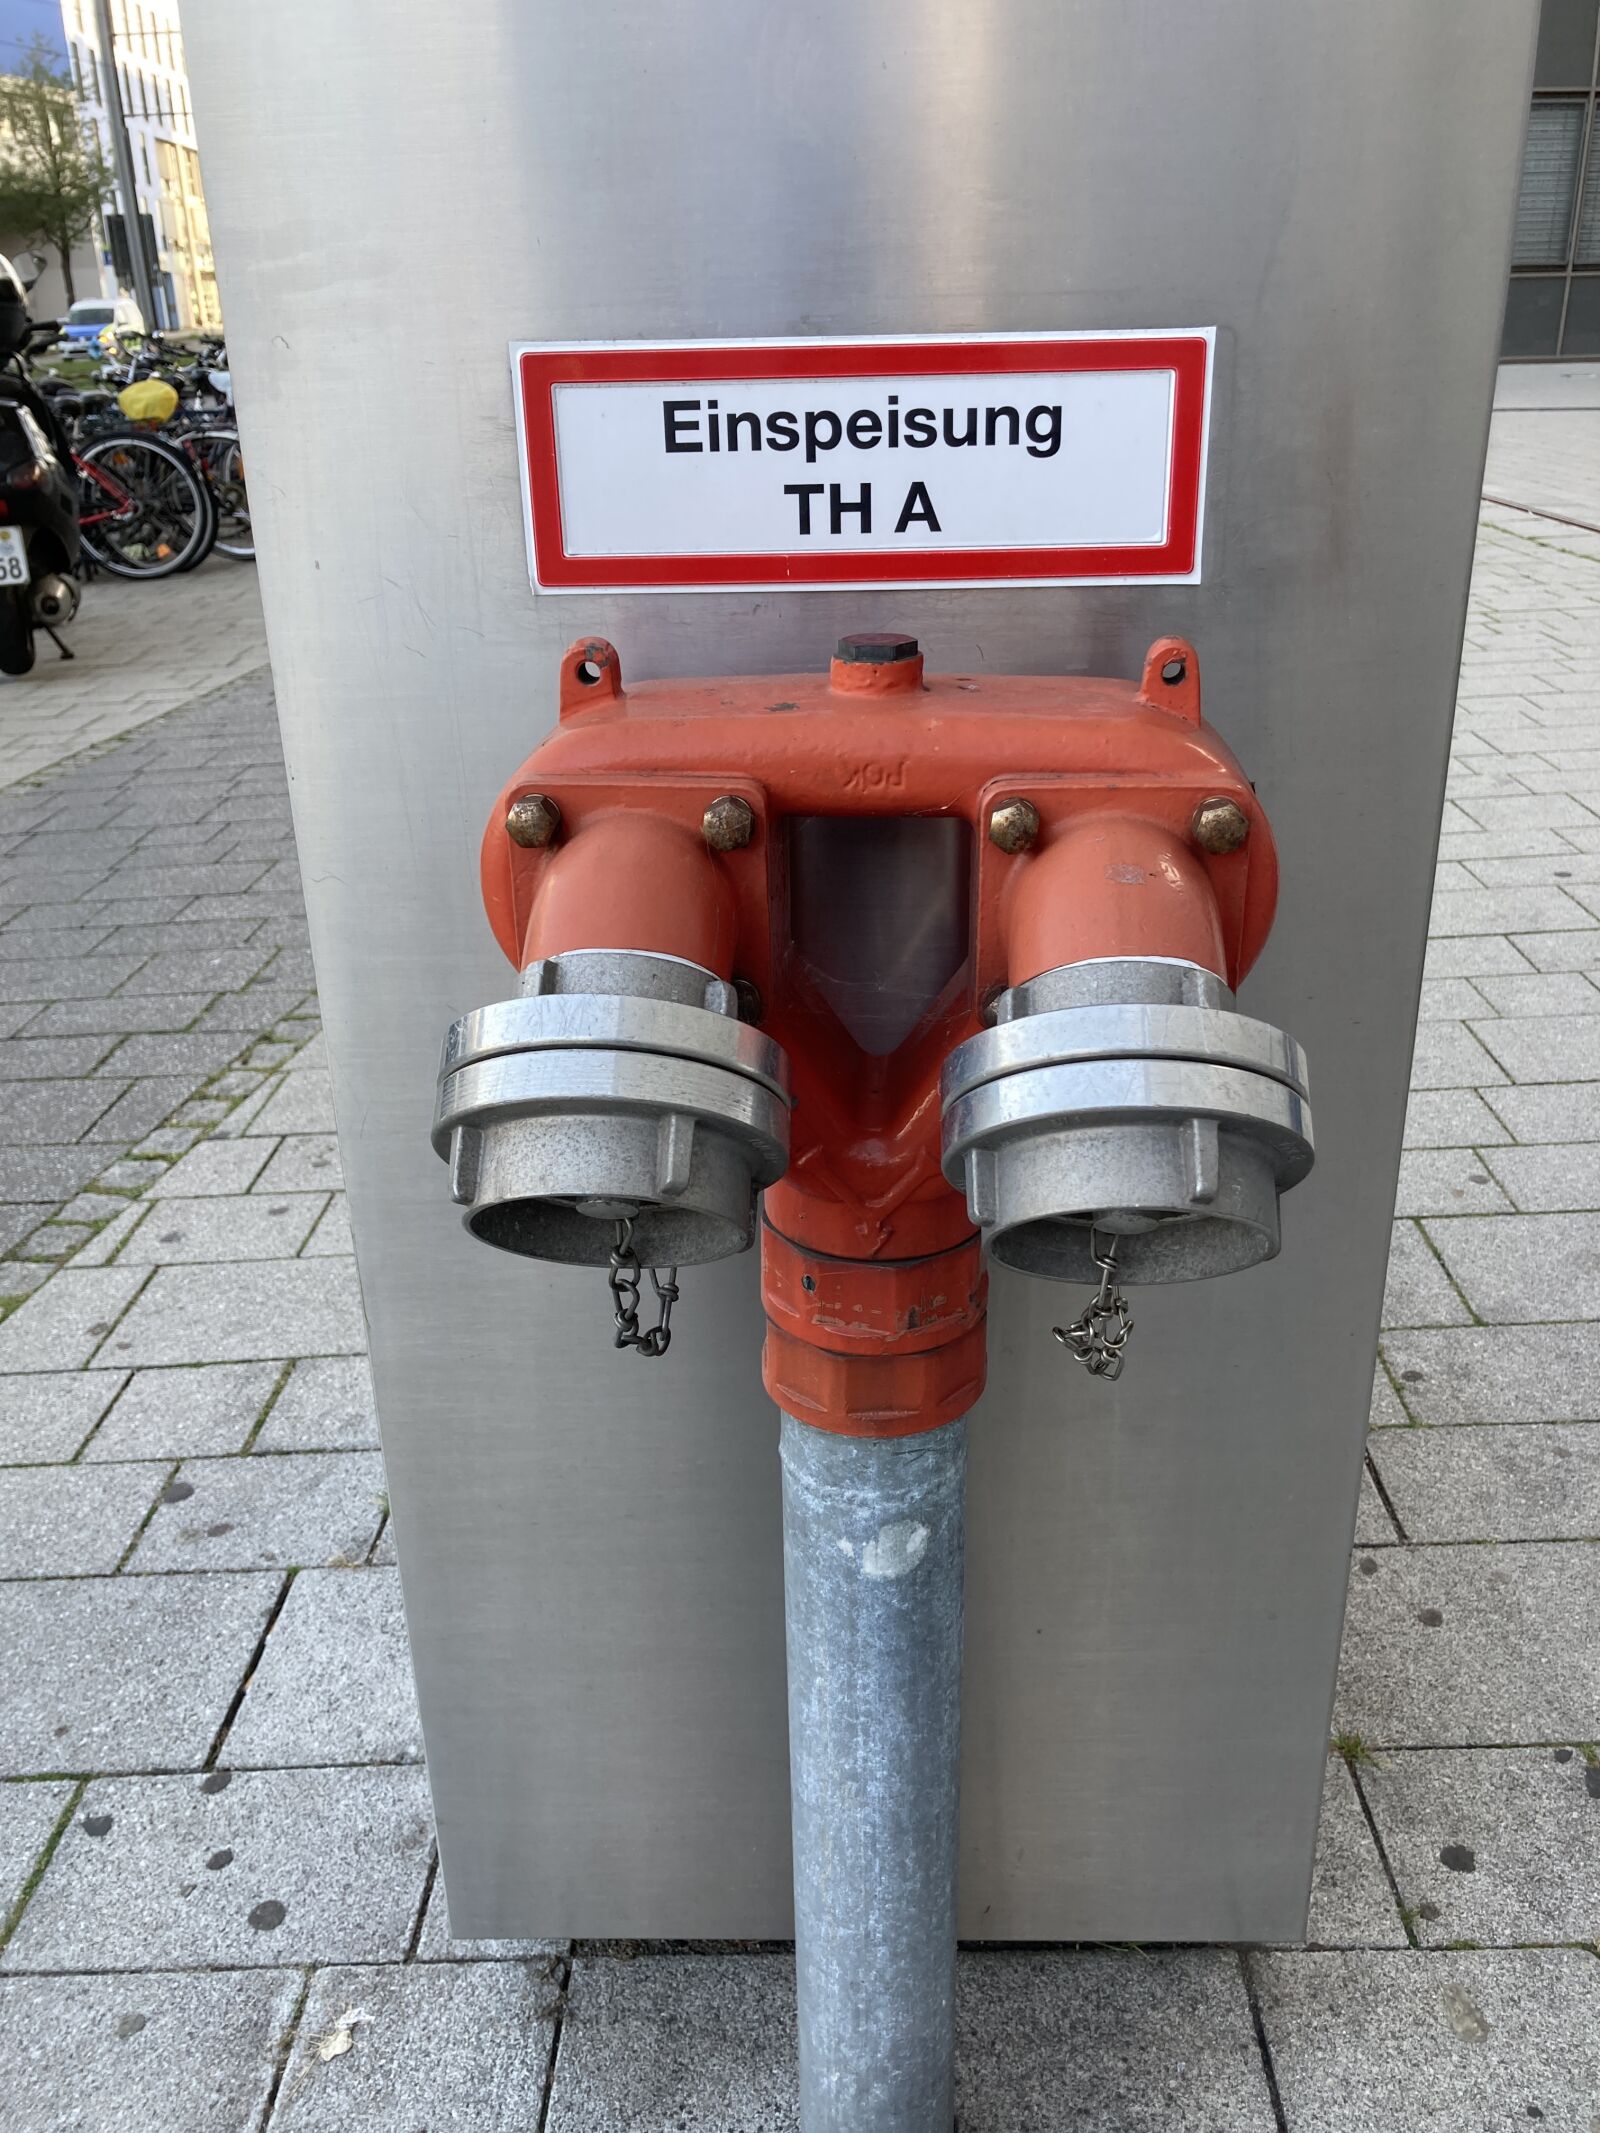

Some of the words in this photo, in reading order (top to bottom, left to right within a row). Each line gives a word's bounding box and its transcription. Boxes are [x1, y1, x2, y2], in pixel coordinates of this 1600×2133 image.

[663, 395, 1062, 463] Einspeisung
[783, 483, 872, 536] TH
[894, 481, 942, 533] A
